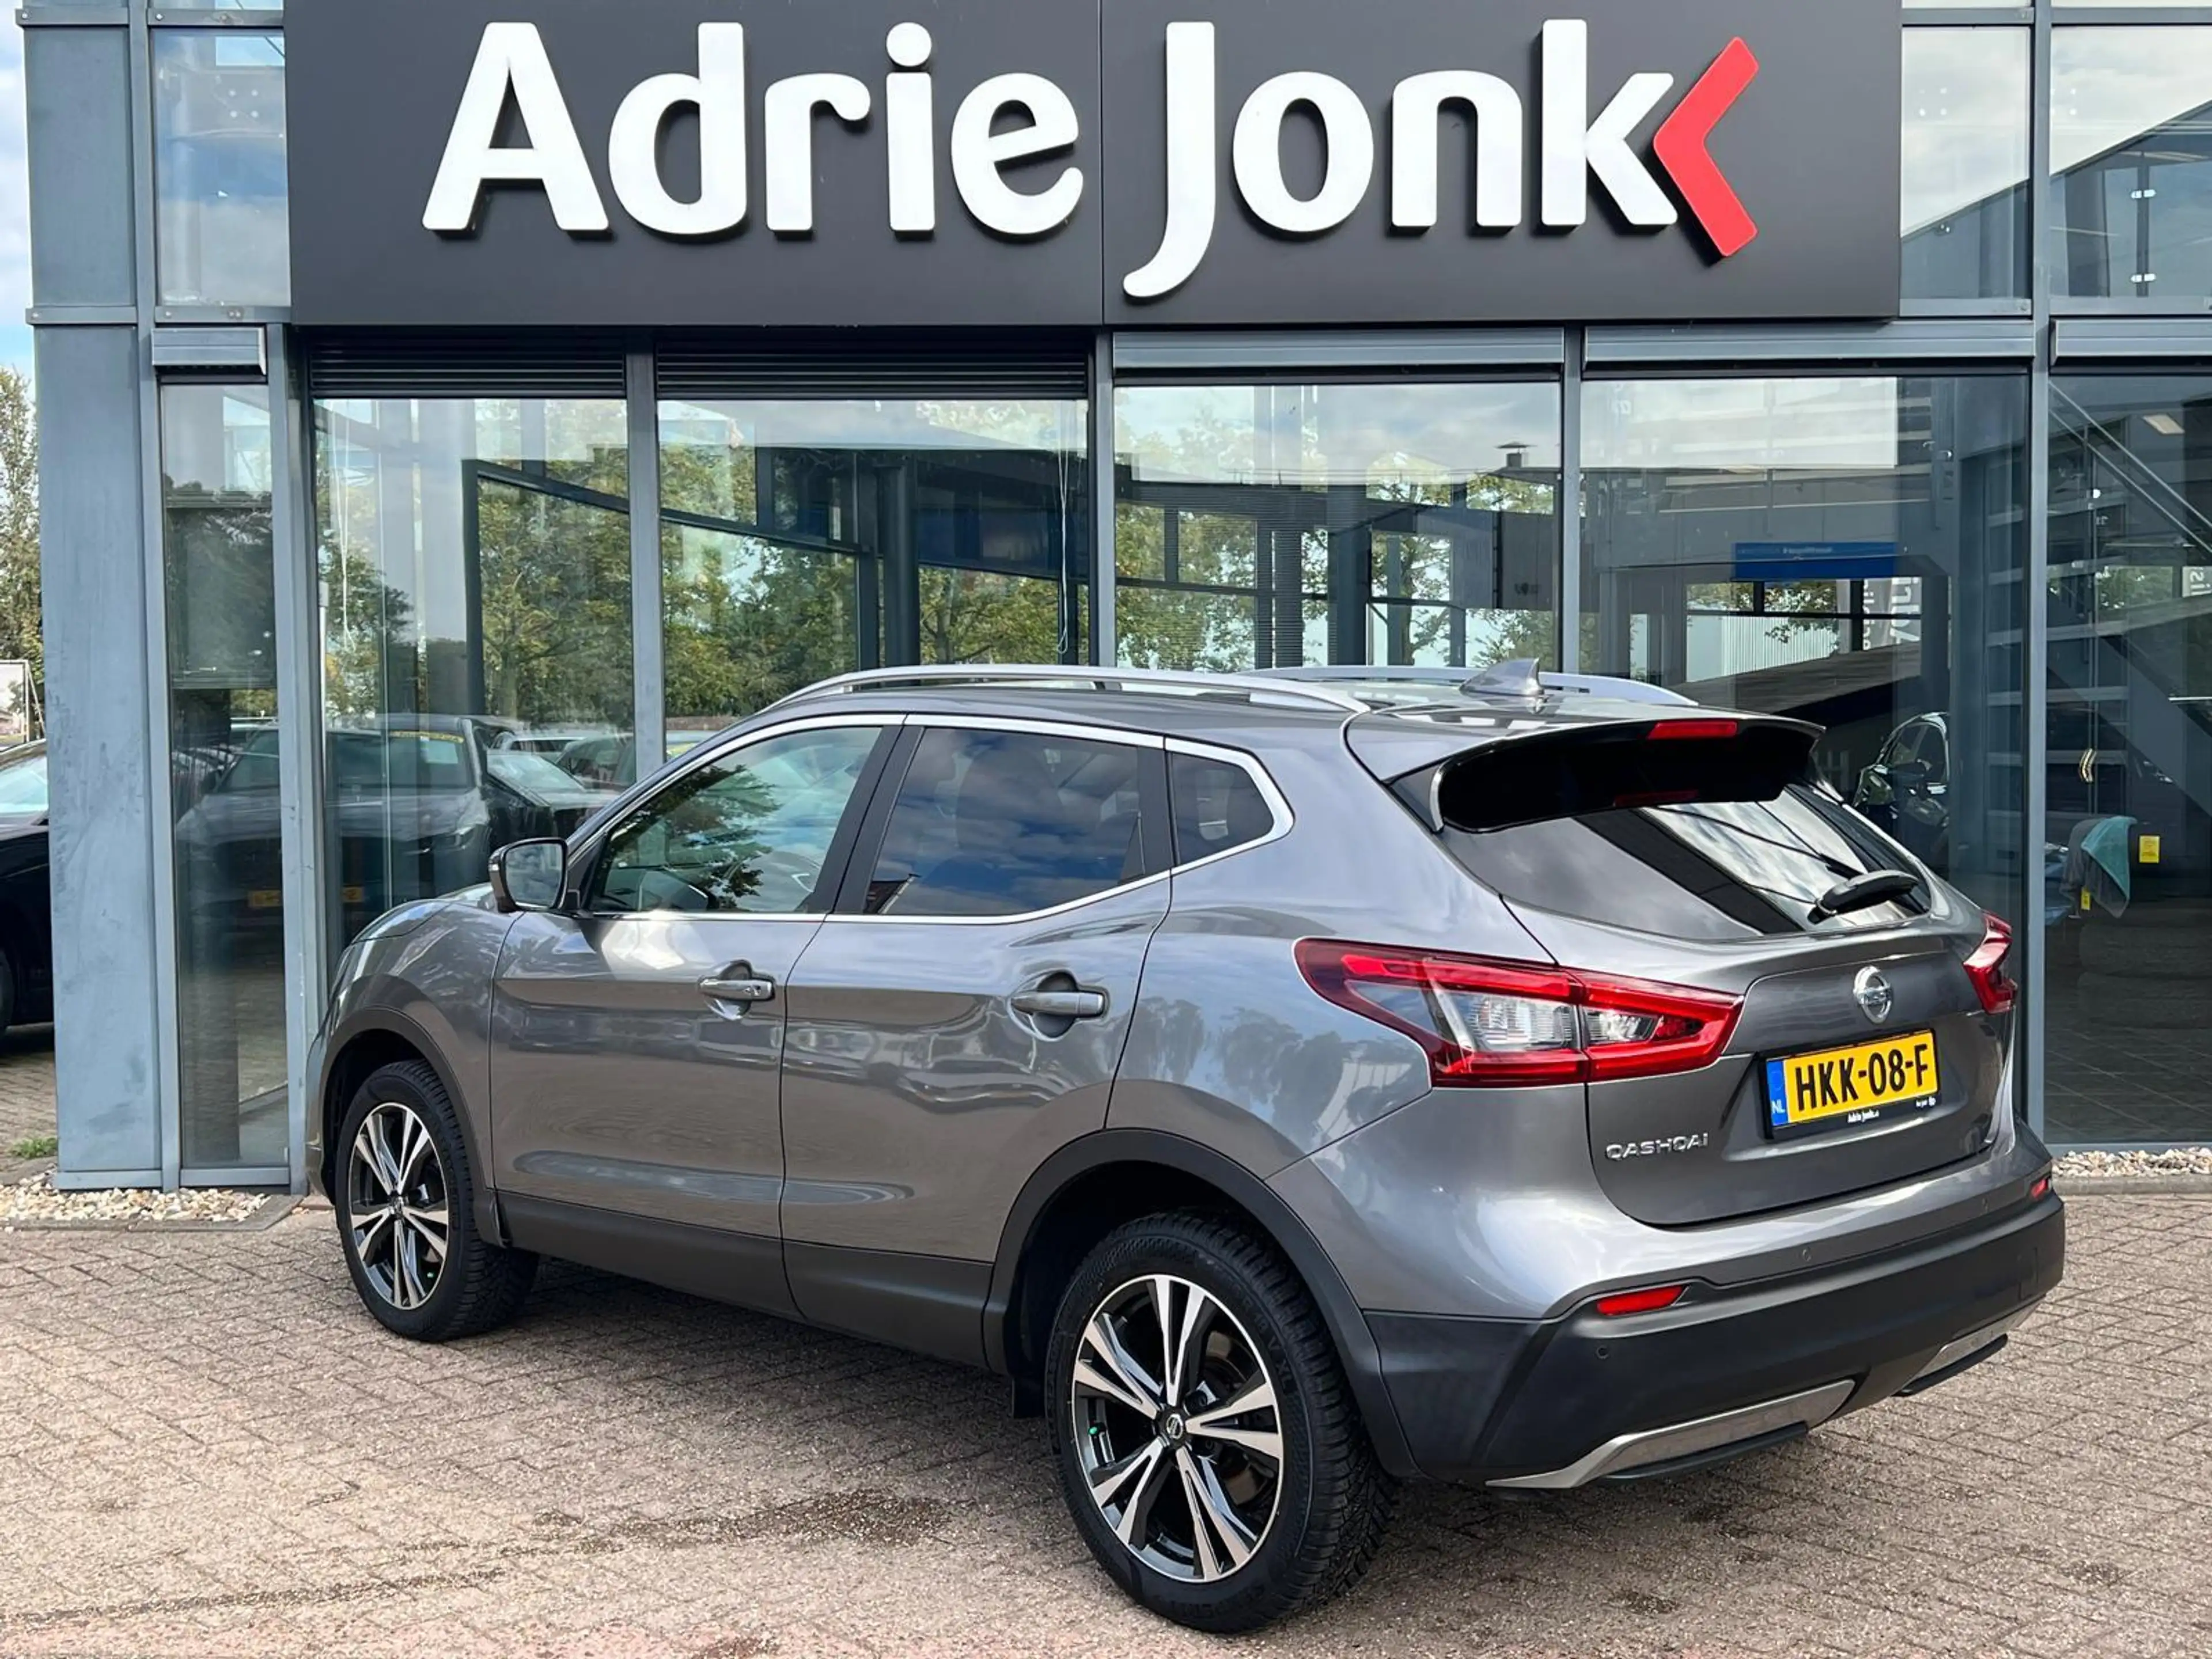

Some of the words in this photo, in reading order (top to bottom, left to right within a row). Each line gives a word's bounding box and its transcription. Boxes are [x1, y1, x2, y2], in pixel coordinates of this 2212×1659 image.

[422, 22, 1084, 234] Adrie
[1123, 19, 1679, 297] Jonk
[1795, 1043, 1929, 1112] HKK-08-F
[1771, 1099, 1785, 1114] NL
[1605, 1132, 1709, 1161] QASHQAI
